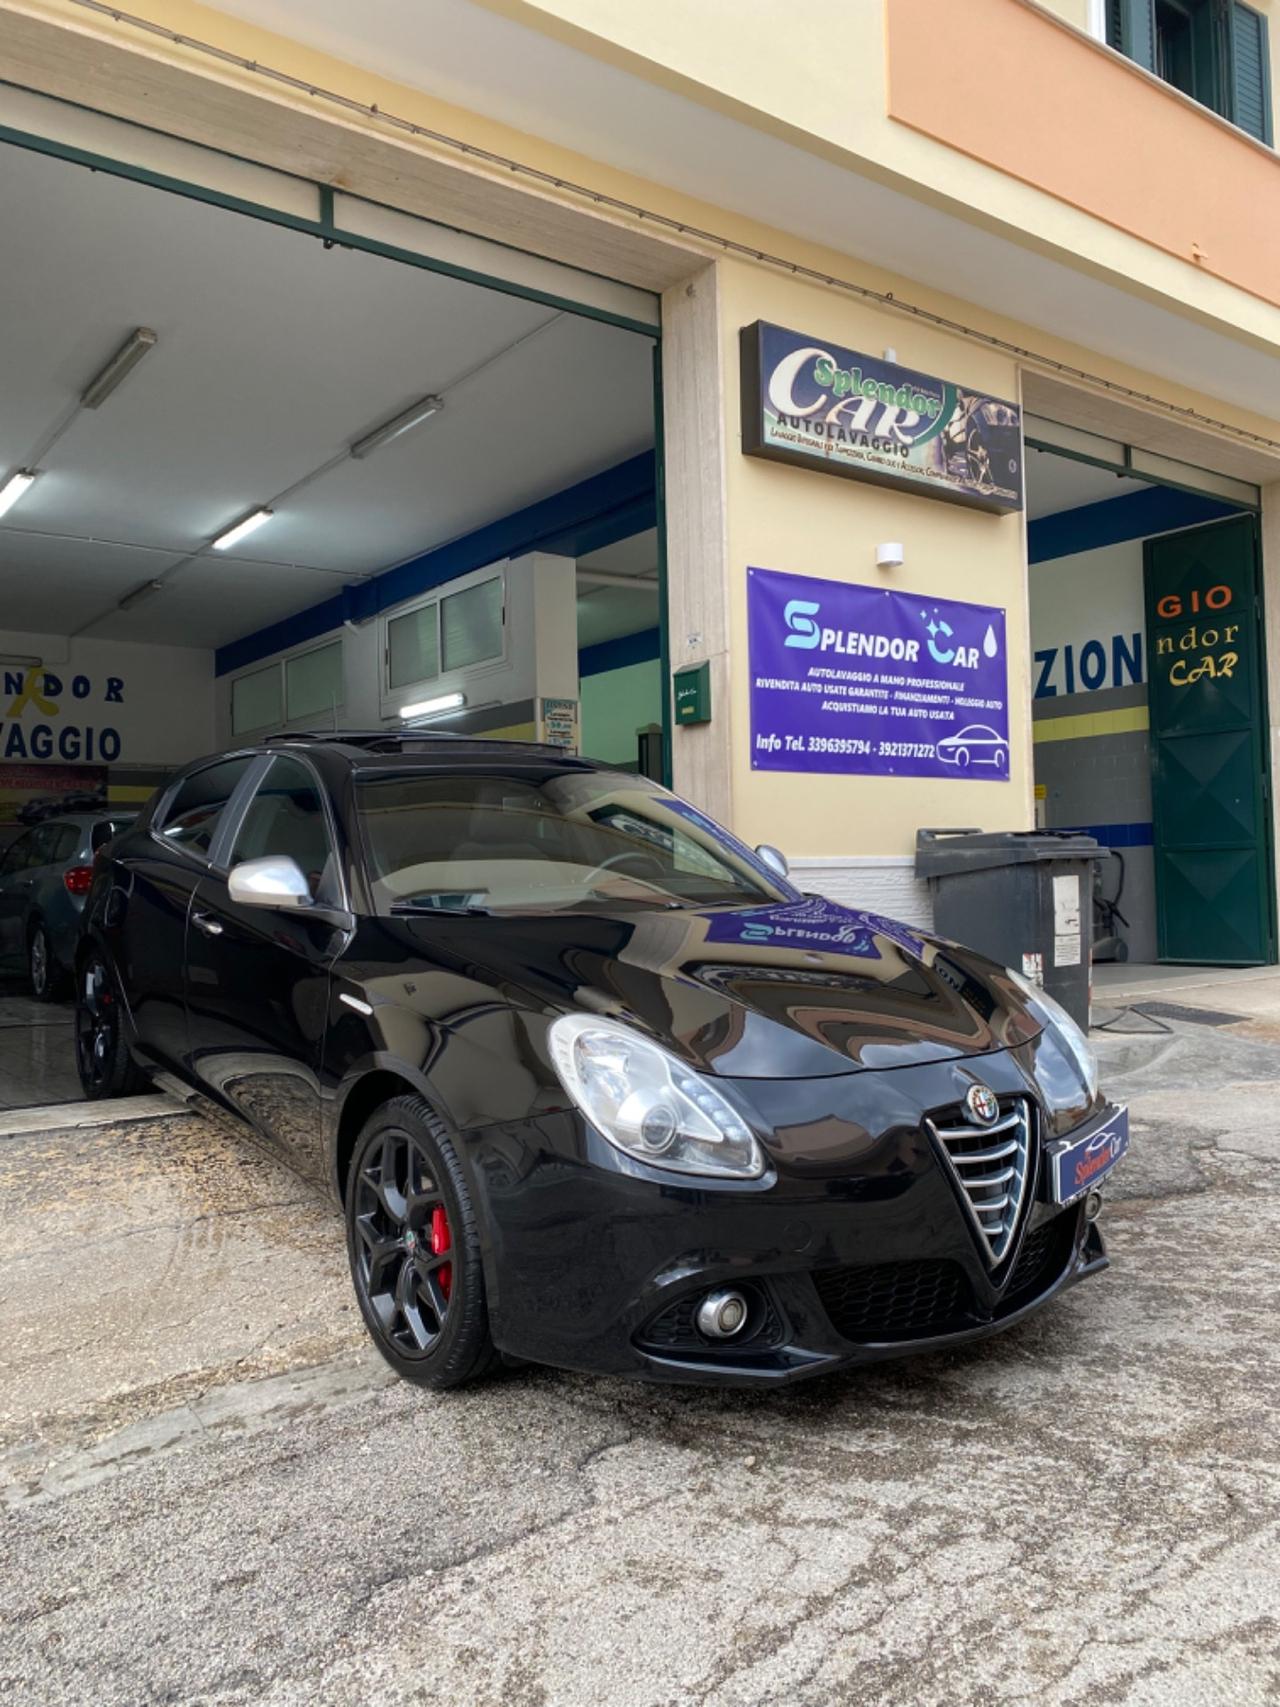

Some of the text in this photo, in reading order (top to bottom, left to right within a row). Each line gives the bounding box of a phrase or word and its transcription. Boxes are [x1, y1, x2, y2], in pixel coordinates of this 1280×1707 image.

[768, 347, 919, 446] CAR
[814, 357, 940, 419] Splendor
[777, 414, 909, 458] AUTOLAVAGGIO
[1157, 584, 1232, 618] GIO
[784, 600, 980, 669] SPLENDOR CAR
[1157, 624, 1239, 655] ndor
[808, 667, 965, 692] AUTOLAVAGGIO A MANO PROFESSIONALE
[1034, 633, 1143, 699] ZION
[1169, 651, 1239, 687] CAR
[756, 678, 799, 691] RIVENDITA
[801, 681, 823, 693] AUTO
[824, 685, 847, 696] USATE
[848, 687, 889, 700] GARANTITE
[985, 698, 1003, 711] AUTO
[821, 701, 955, 720] ACQUISTIAMO LA TUA AUTO USATA
[0, 722, 121, 761] AGGIO
[756, 733, 781, 753] Info
[785, 736, 805, 751] Tel.
